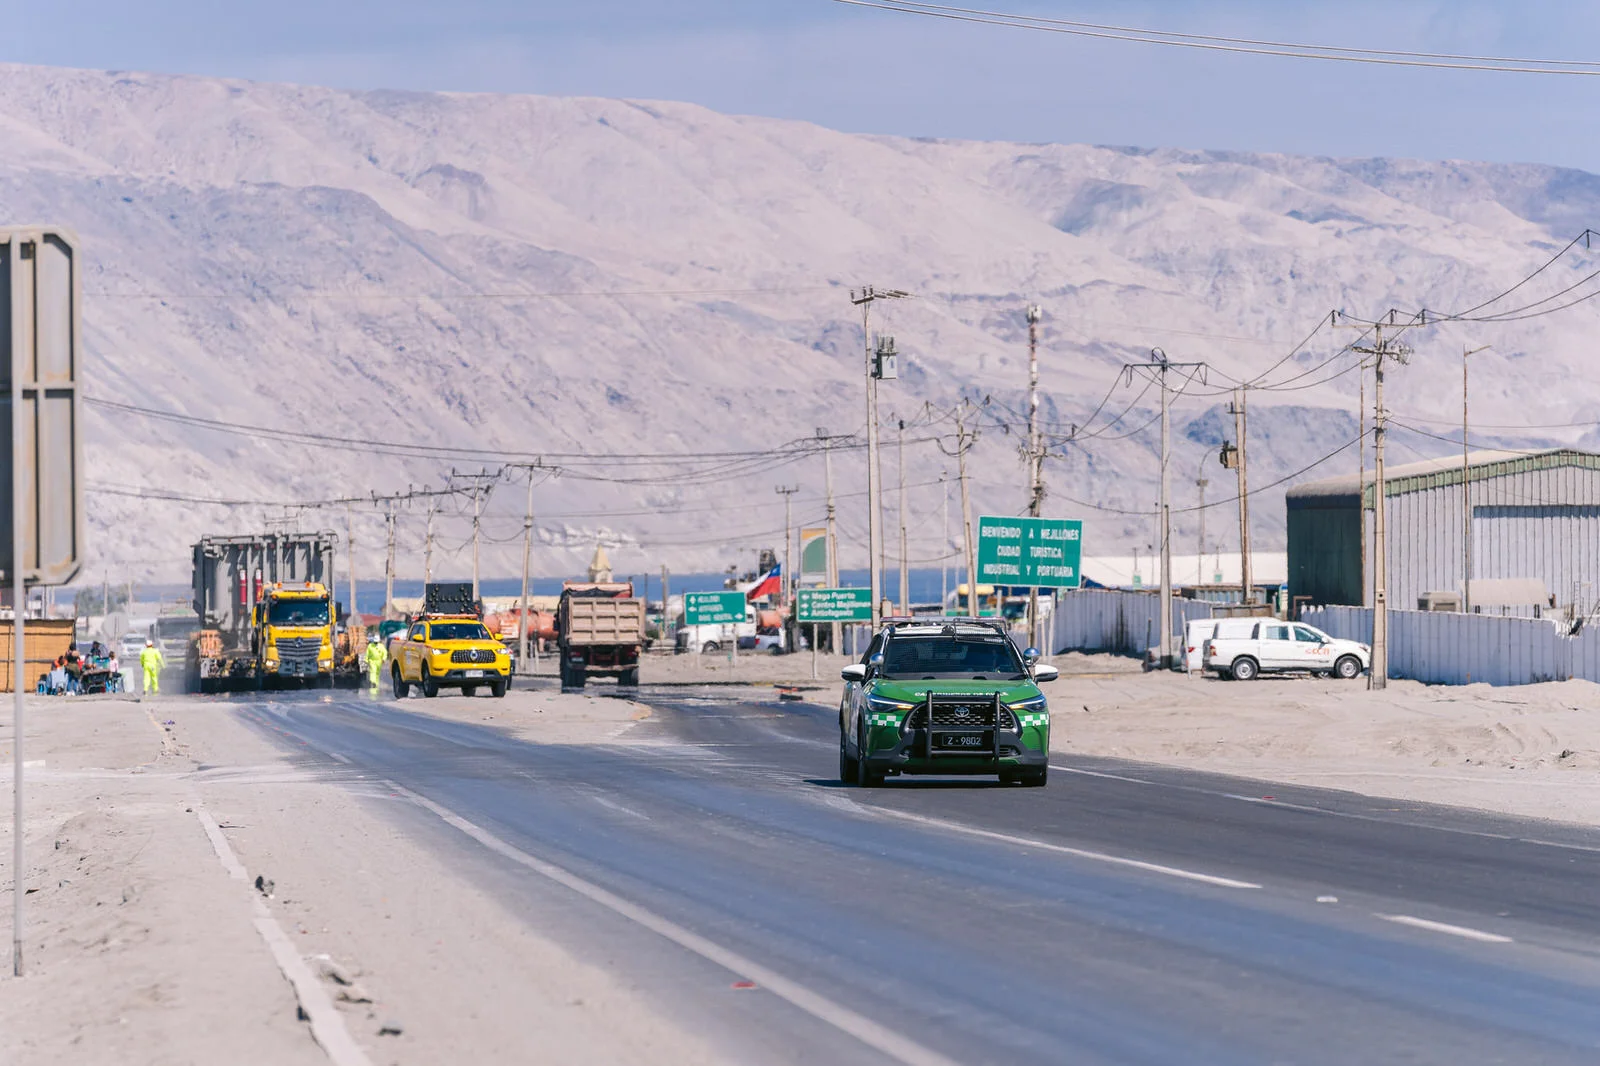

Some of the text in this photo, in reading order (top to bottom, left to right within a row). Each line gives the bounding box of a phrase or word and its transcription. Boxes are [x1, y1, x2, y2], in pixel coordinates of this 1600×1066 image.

[1028, 528, 1034, 539] A
[1041, 528, 1079, 541] MEJILLONES
[997, 545, 1020, 557] CIUDAD
[1026, 565, 1031, 576] Y
[1037, 565, 1073, 577] PORTUARIA
[811, 592, 856, 601] Mega Puerto
[811, 601, 835, 609] Centro
